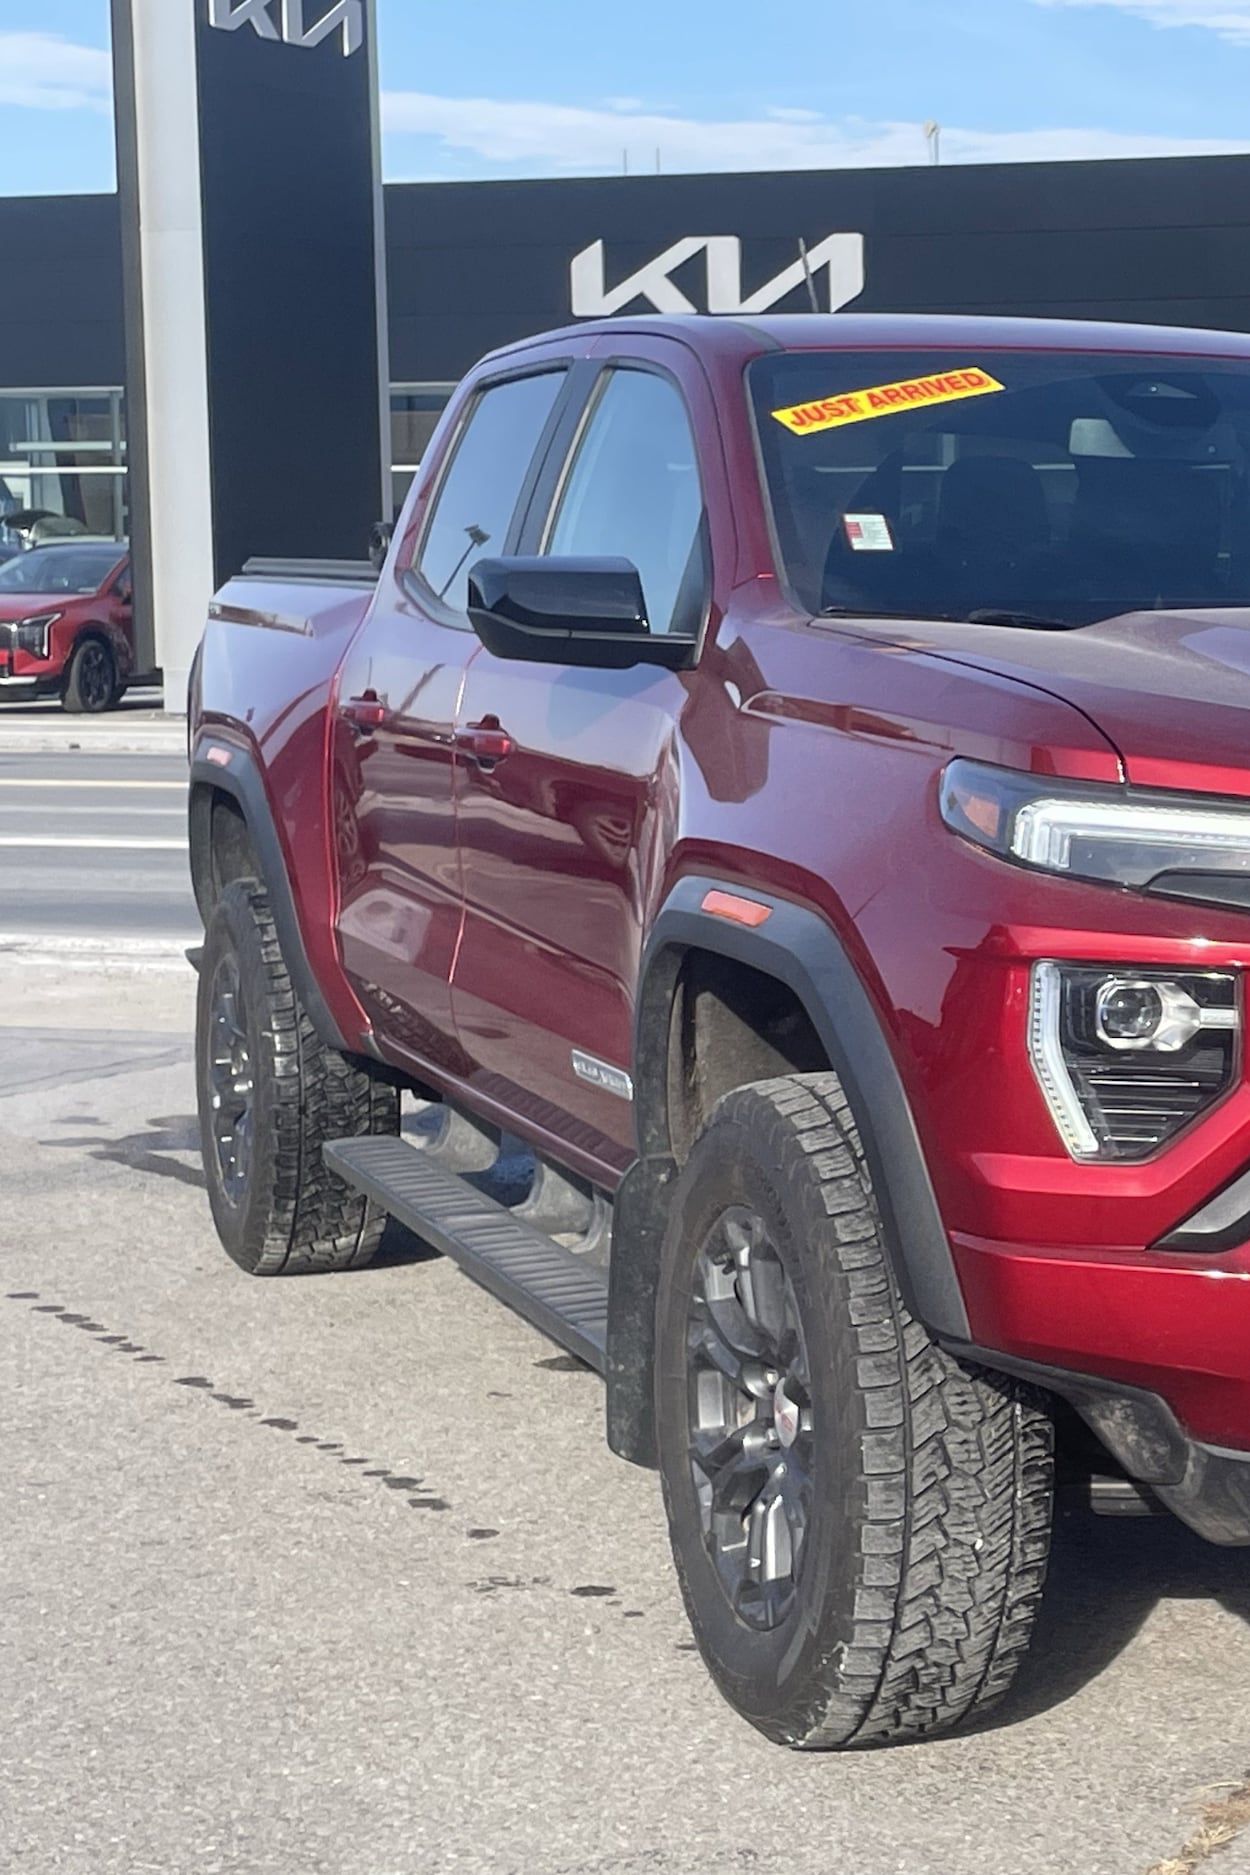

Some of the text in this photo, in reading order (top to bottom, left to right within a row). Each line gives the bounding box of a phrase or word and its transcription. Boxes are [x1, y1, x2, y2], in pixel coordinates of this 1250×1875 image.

[570, 232, 864, 317] KIA
[790, 371, 988, 428] JUST ARRIVED
